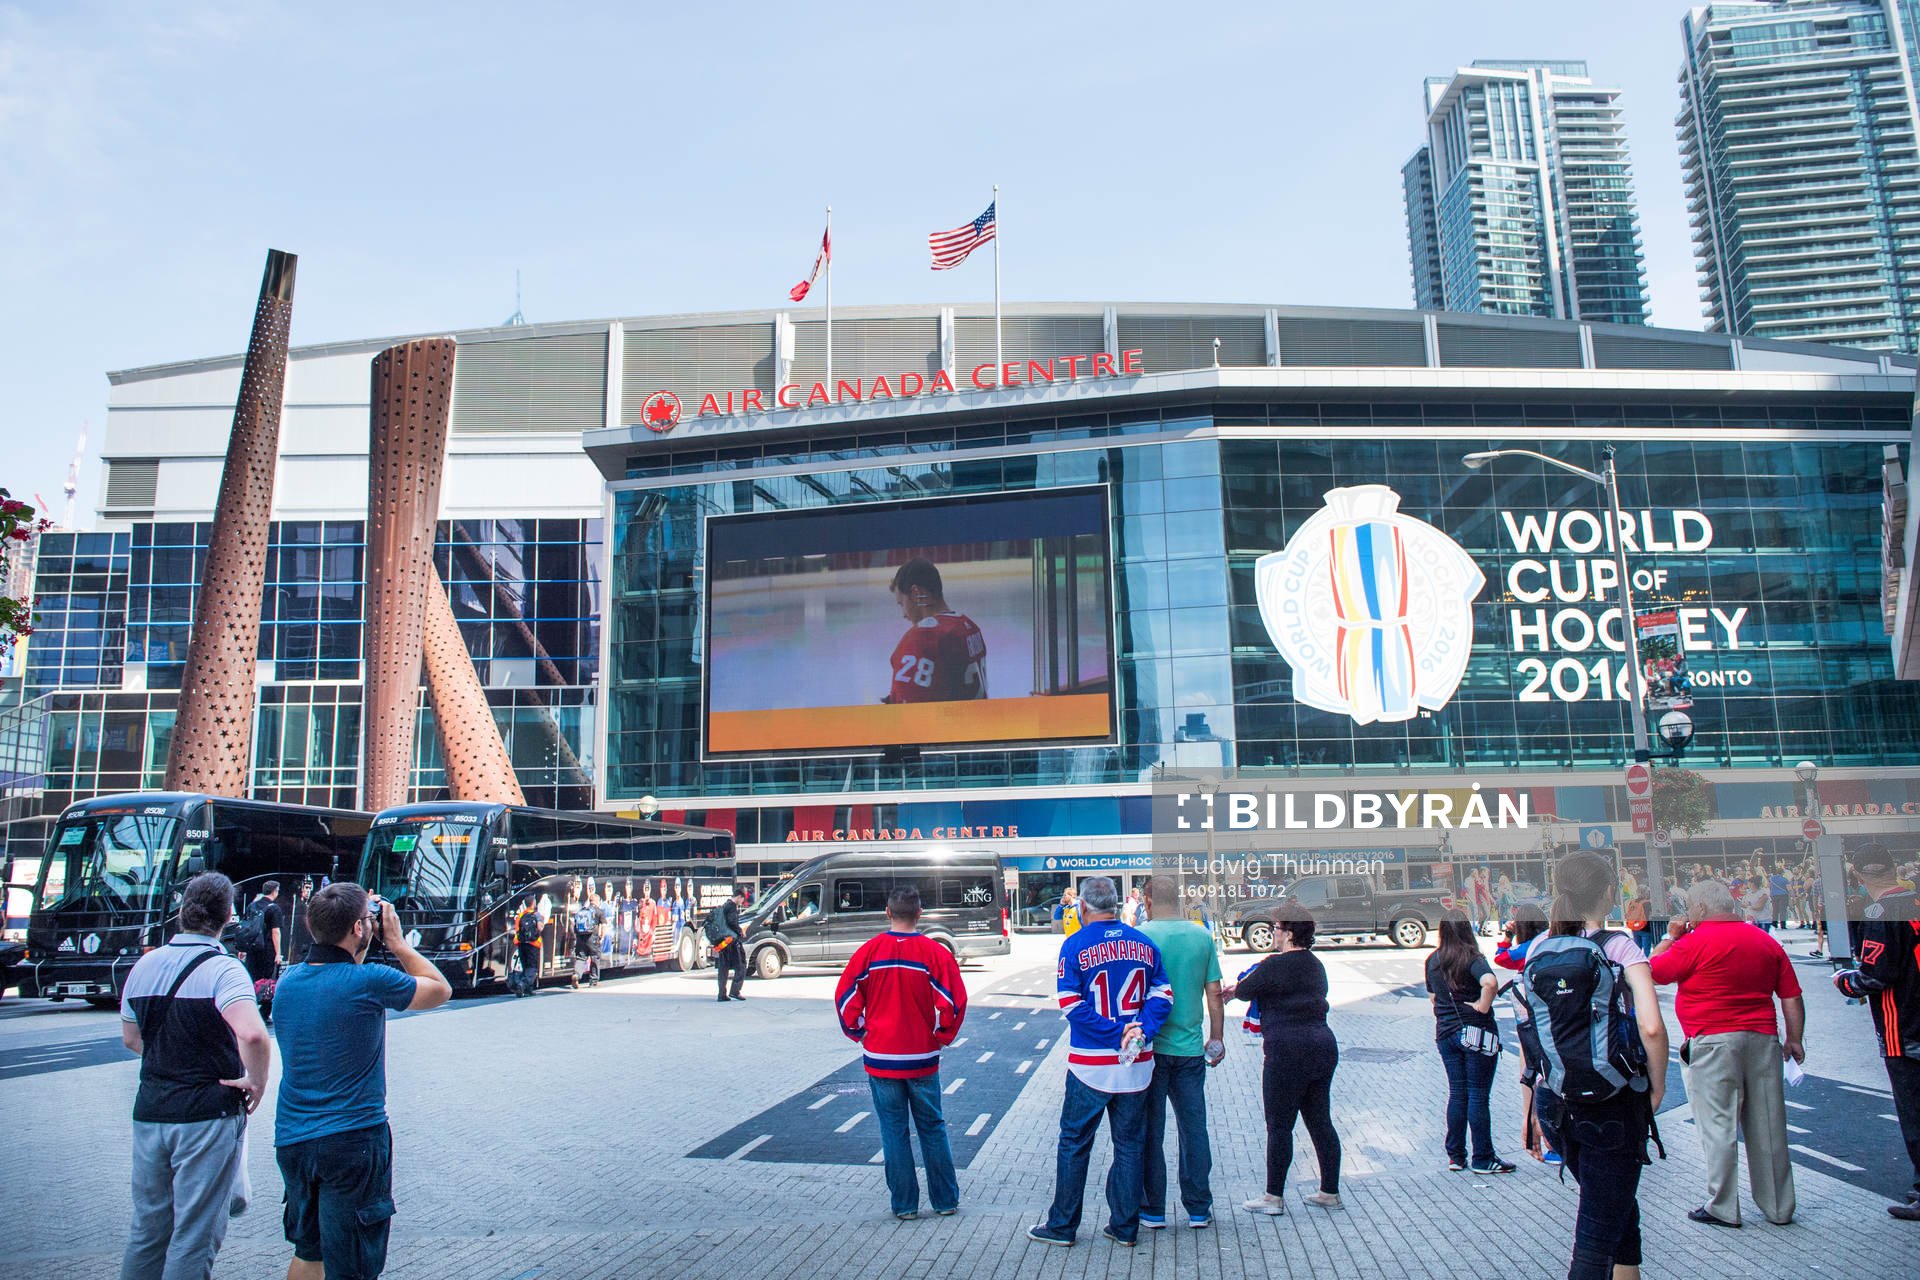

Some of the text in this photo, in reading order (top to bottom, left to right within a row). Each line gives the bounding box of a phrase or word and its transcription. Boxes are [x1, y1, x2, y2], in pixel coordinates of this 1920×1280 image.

[698, 349, 1145, 417] AIR CANADA CENTRE
[1501, 510, 1714, 554] WORLD
[1507, 559, 1669, 603] CUP OF
[1510, 607, 1749, 652] HOCEY
[895, 655, 935, 688] 28
[1516, 657, 1753, 702] 2016 RONTO
[144, 807, 166, 815] 85018
[1630, 802, 1650, 814] WRONG
[1760, 806, 1800, 819] AIR
[1805, 803, 1897, 817] ANADA
[454, 815, 477, 823] 85033
[186, 830, 209, 838] 85018
[785, 825, 1019, 842] AIR CANADA CENTRE
[1060, 858, 1099, 868] WORLD
[1100, 858, 1120, 867] CUP
[963, 893, 993, 903] KING
[1078, 940, 1154, 971] SHANAHAN
[1089, 967, 1147, 1023] 14
[1555, 988, 1574, 996] deuter
